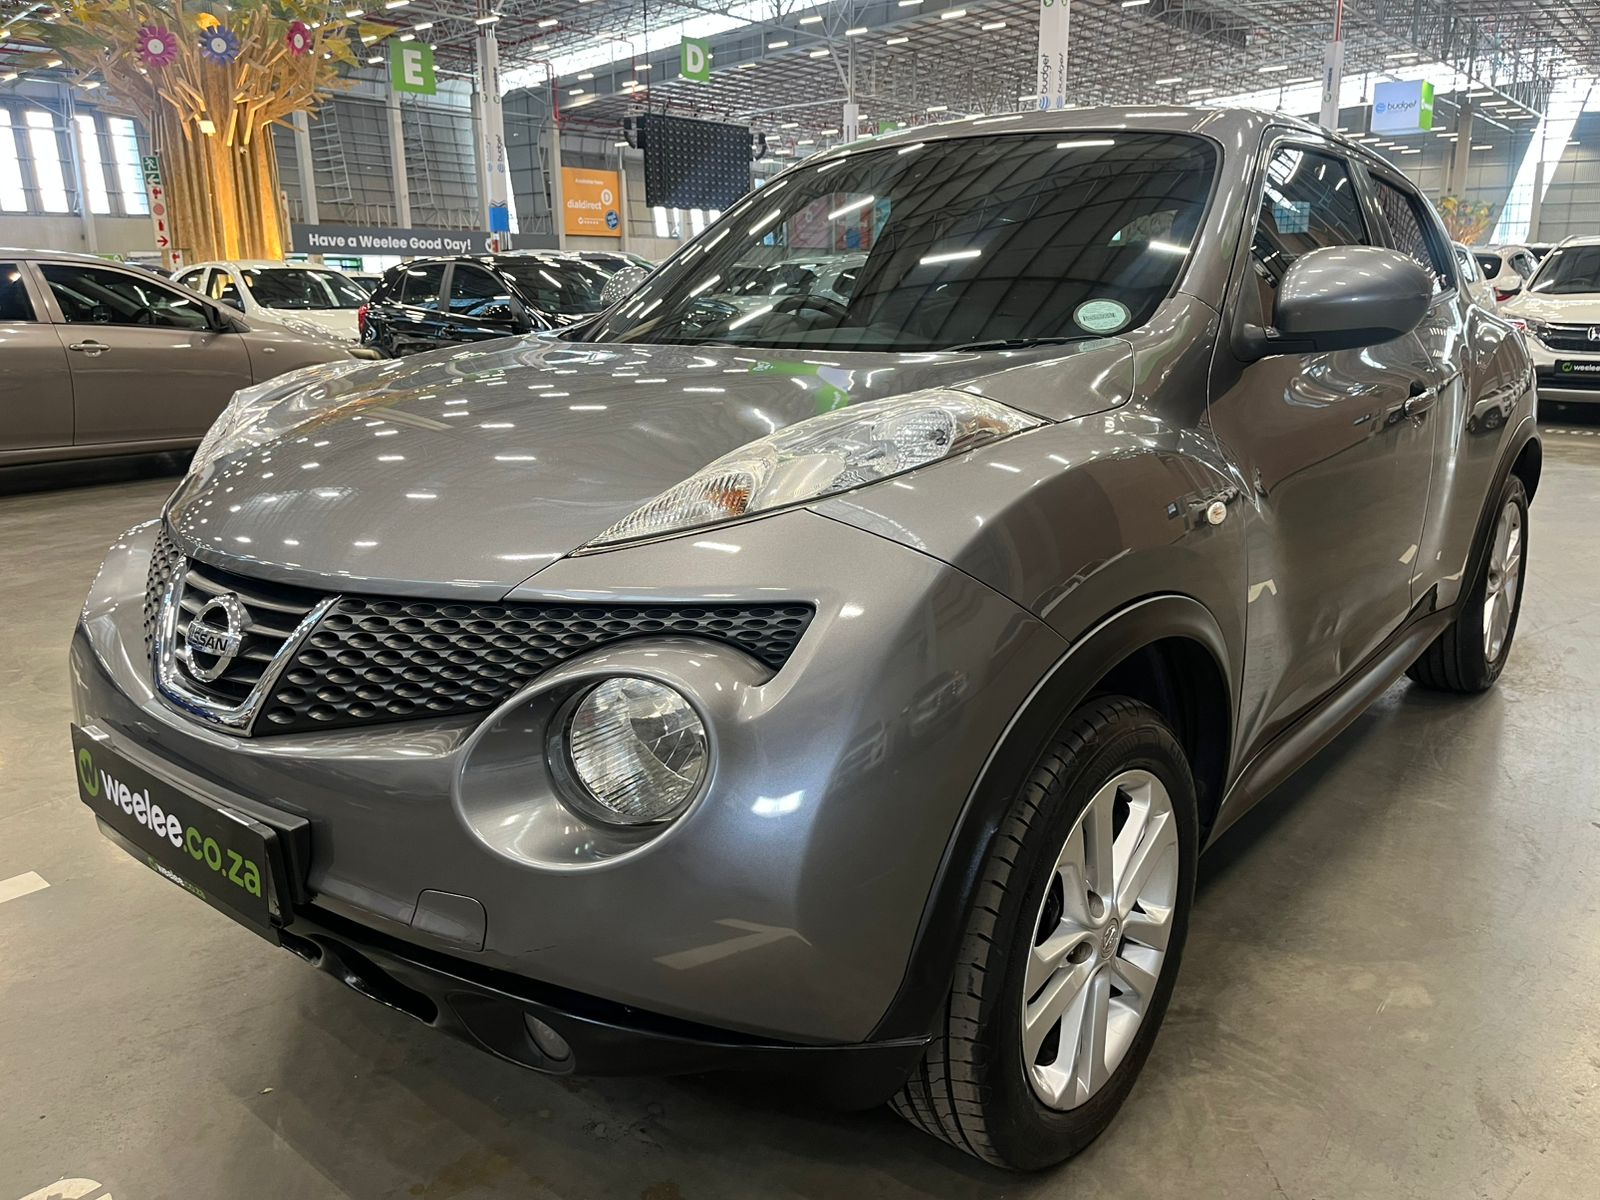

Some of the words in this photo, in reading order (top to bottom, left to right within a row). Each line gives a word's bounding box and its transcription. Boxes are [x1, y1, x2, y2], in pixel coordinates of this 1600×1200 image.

[403, 48, 424, 86] E
[686, 43, 705, 74] D
[1040, 53, 1052, 94] budget
[1387, 100, 1417, 112] budget
[567, 199, 602, 210] dialdirect
[308, 233, 345, 247] Have
[347, 237, 357, 247] a
[358, 235, 408, 248] Weelee
[409, 237, 442, 250] Good
[443, 238, 472, 254] Day!
[100, 769, 262, 898] weelee.co.za
